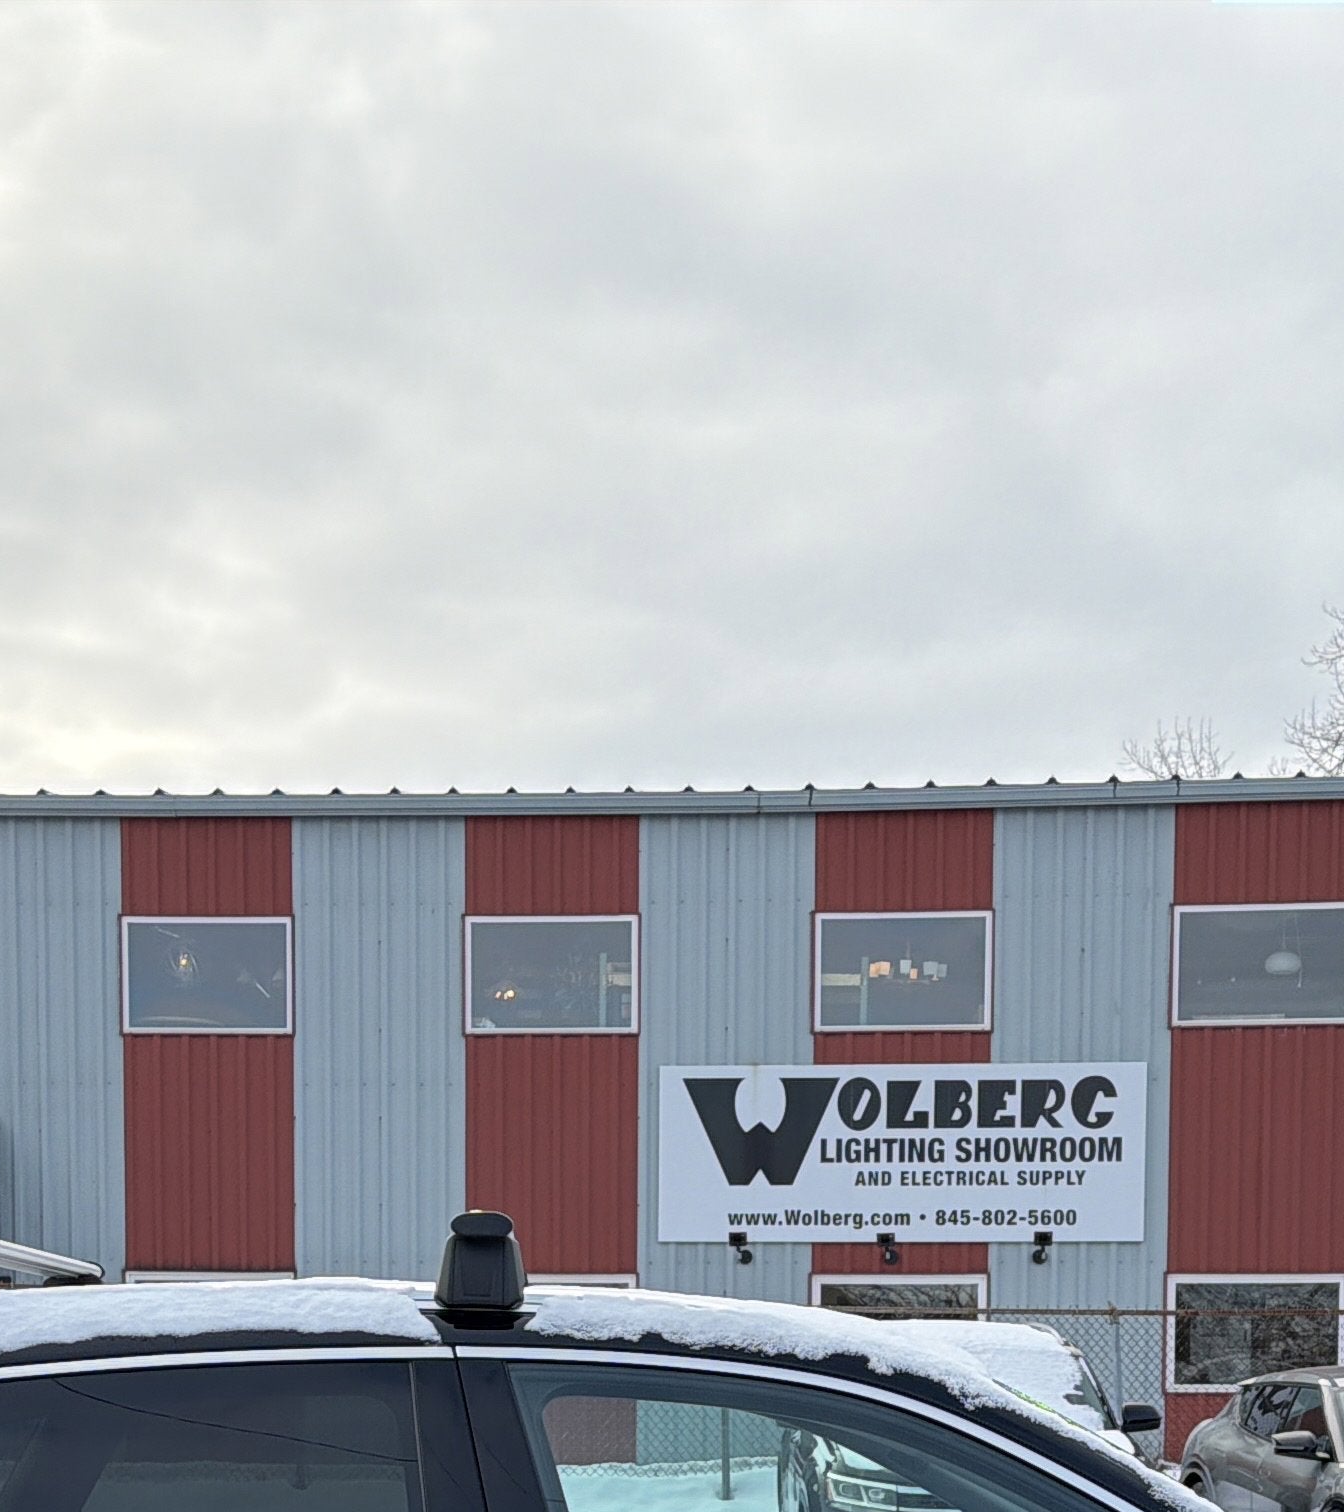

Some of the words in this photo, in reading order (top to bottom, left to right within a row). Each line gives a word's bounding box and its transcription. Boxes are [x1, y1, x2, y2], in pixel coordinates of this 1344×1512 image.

[682, 1076, 1119, 1186] WOLBERG
[820, 1137, 945, 1164] LIGHTING
[954, 1136, 1124, 1163] SHOWROOM
[854, 1170, 892, 1187] AND
[900, 1170, 1010, 1187] ELECTRICAL
[1016, 1169, 1087, 1186] SUPPLY
[727, 1208, 912, 1230] www.Wolberg.com
[934, 1208, 1078, 1227] 845-802-5600
